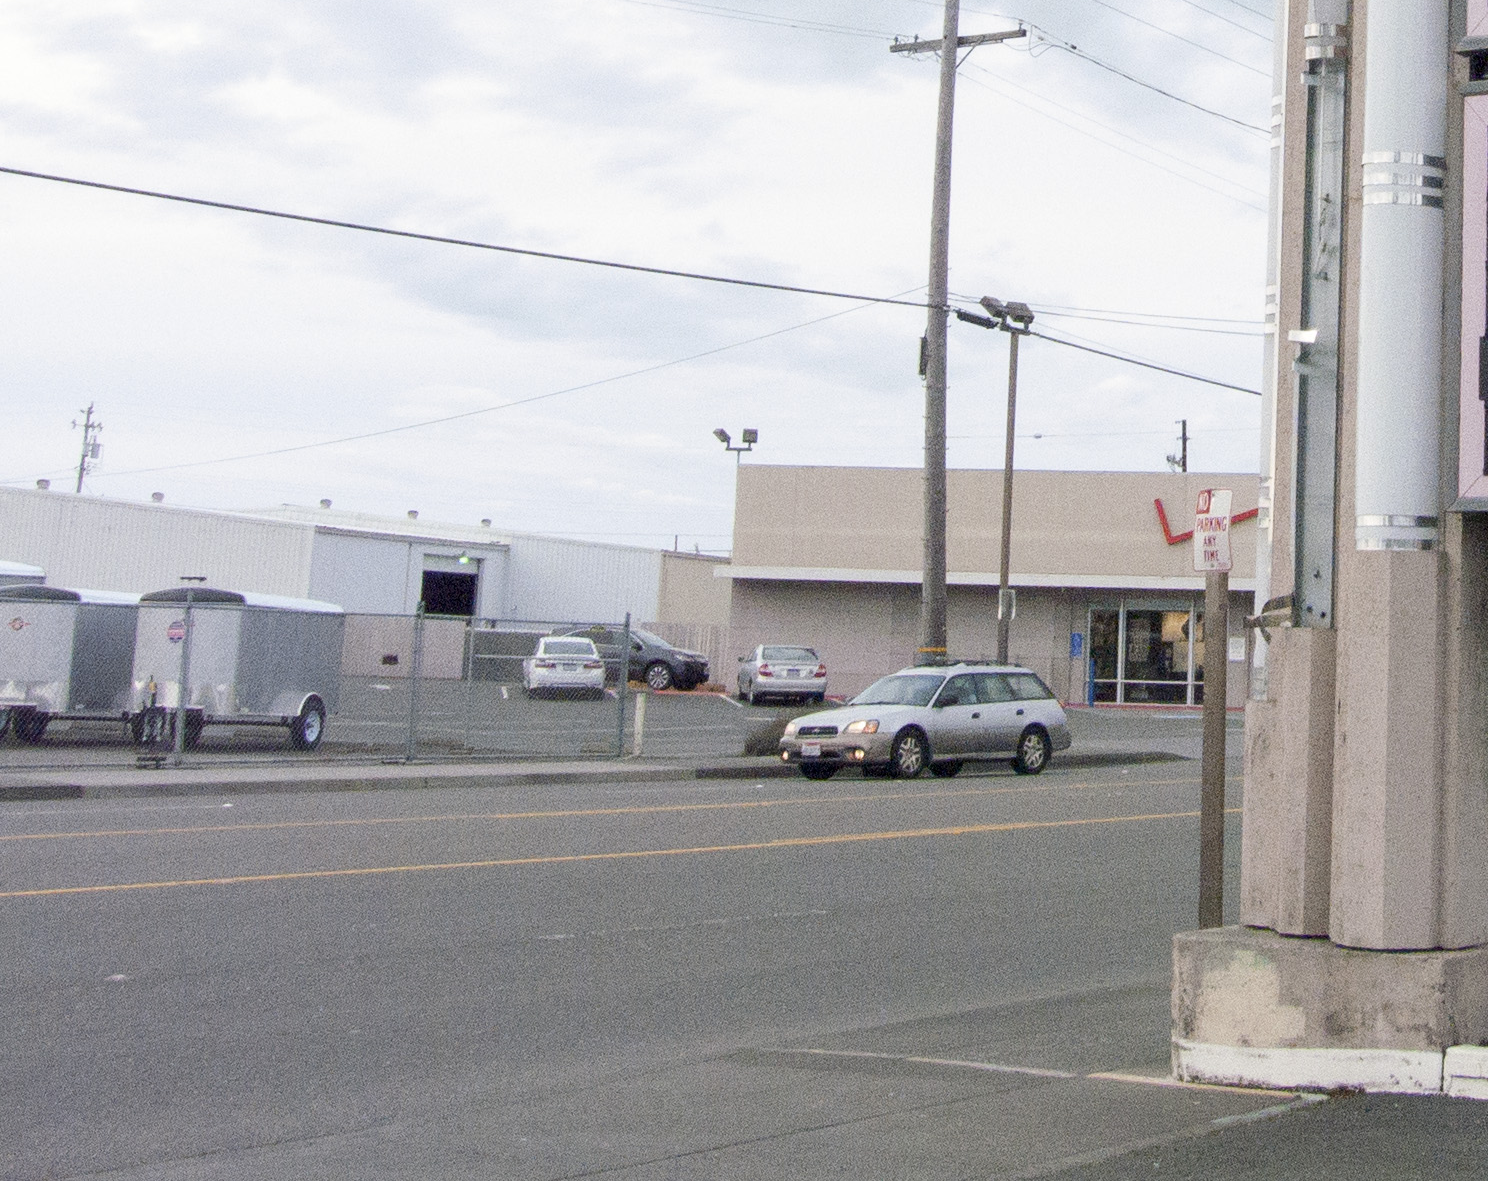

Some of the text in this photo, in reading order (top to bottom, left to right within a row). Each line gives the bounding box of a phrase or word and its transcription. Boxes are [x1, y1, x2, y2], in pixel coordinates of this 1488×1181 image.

[1196, 517, 1228, 533] PARKING
[1203, 535, 1217, 547] ANY
[1203, 550, 1219, 562] TIME
